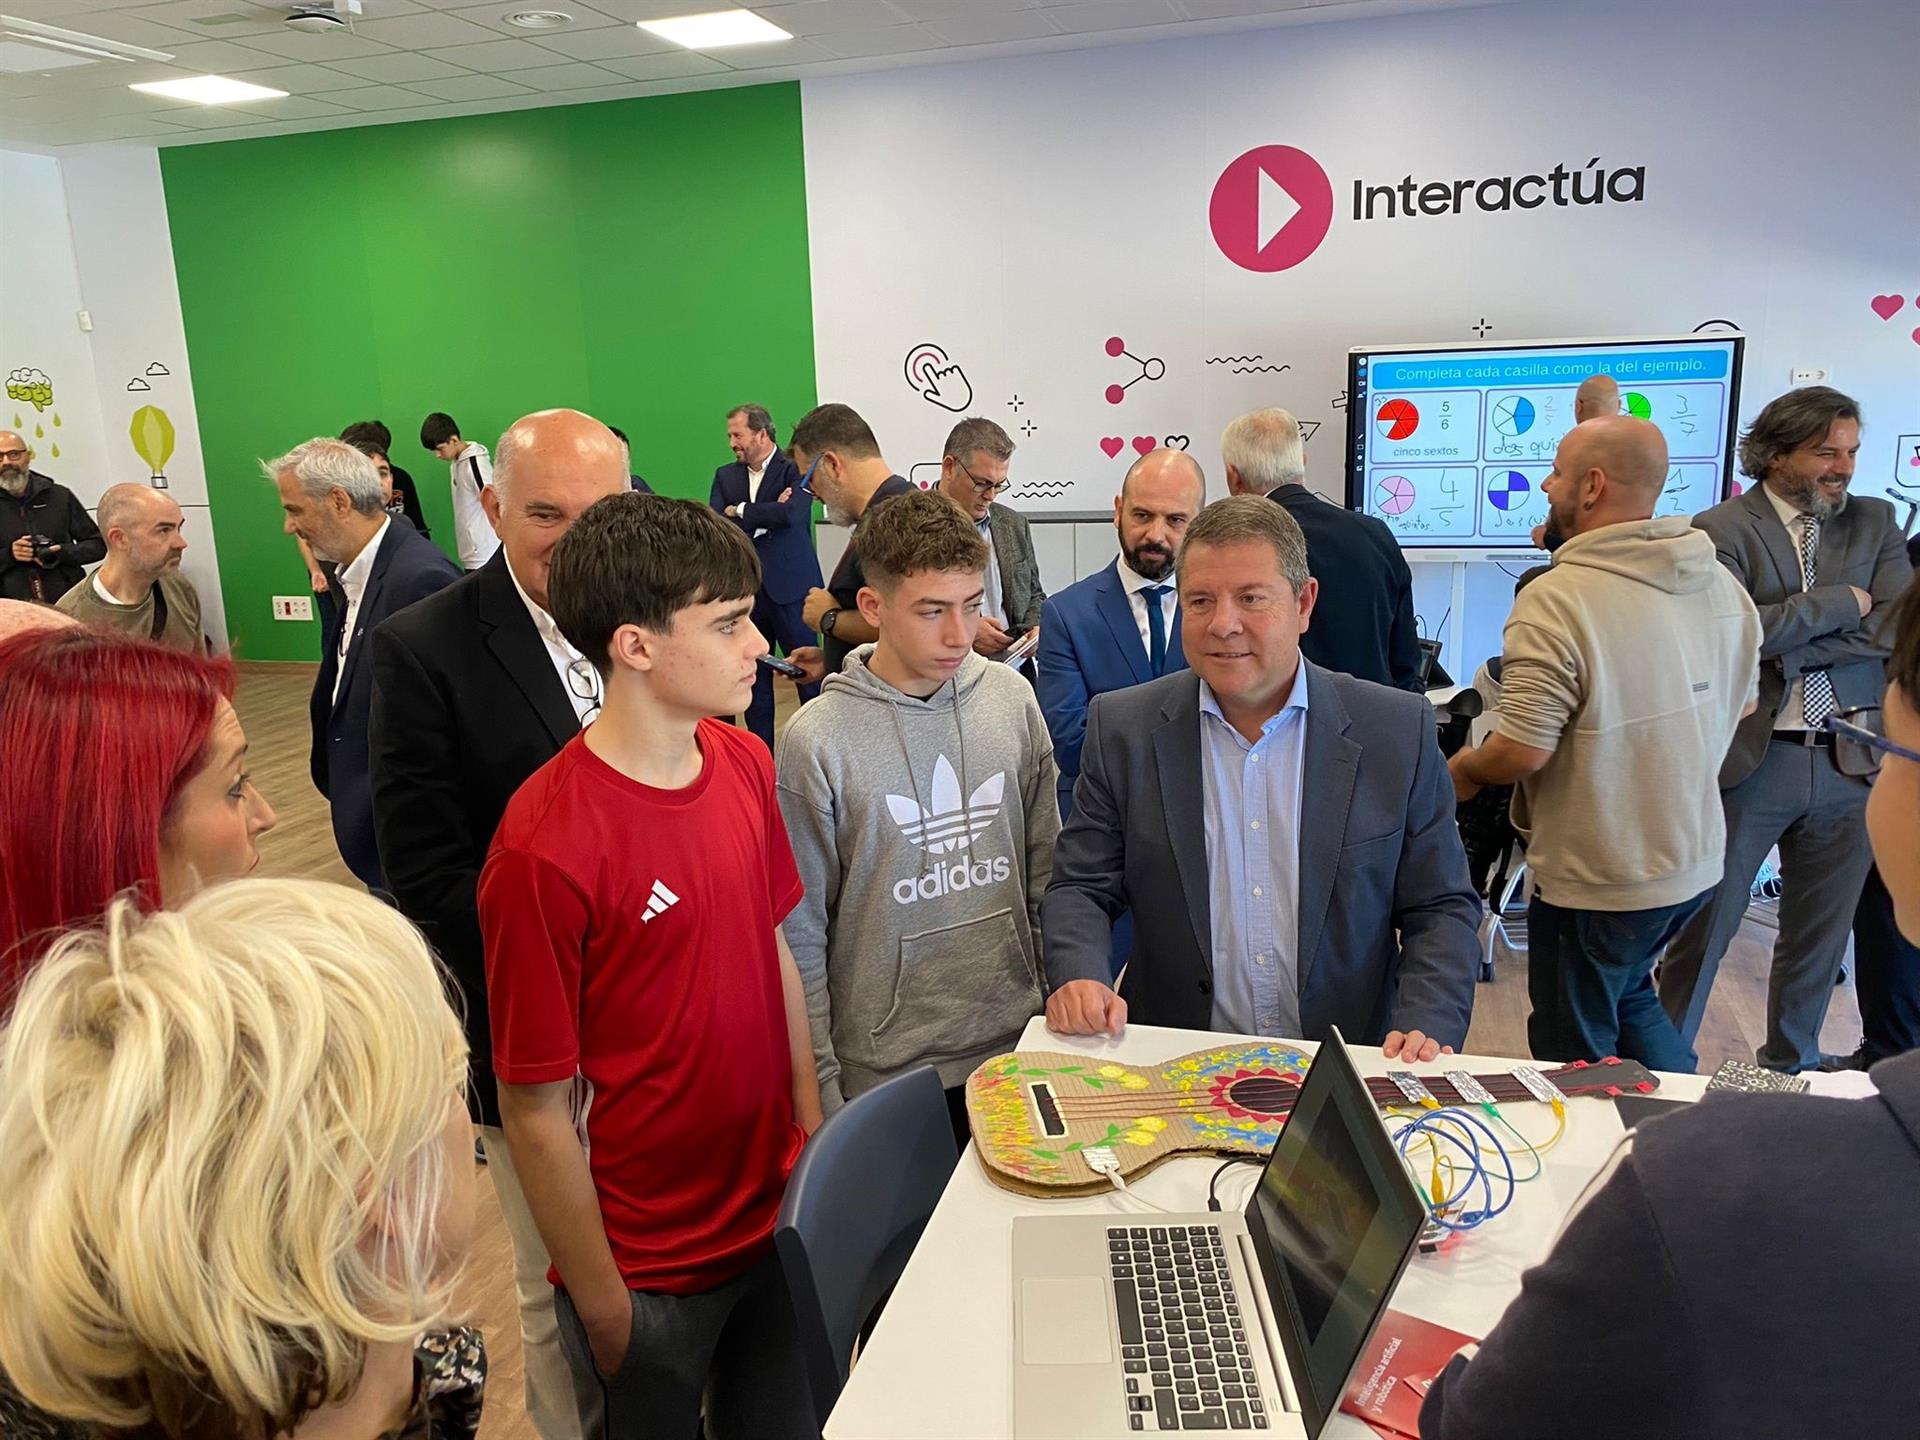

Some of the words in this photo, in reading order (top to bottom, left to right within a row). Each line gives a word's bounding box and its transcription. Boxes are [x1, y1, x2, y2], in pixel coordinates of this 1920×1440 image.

[1353, 157, 1646, 221] Interactúa
[1395, 367, 1462, 382] Completa
[1466, 365, 1500, 378] cada
[1504, 363, 1549, 377] casilla
[1553, 364, 1594, 375] como
[1599, 361, 1611, 374] la
[1615, 360, 1638, 373] del
[1643, 358, 1707, 375] ejemplo.
[1442, 401, 1450, 413] 5
[1676, 395, 1688, 414] 3
[1441, 418, 1450, 430] 6
[1679, 421, 1699, 437] 7
[1393, 446, 1421, 457] cinco
[1424, 445, 1459, 457] sextos
[1440, 469, 1459, 502] 4
[1438, 510, 1454, 527] 5
[892, 855, 1011, 905] adidas
[1354, 1363, 1386, 1407] Inteligencia
[1380, 1337, 1402, 1366] artificial
[1375, 1375, 1398, 1406] robótica
[1371, 1403, 1383, 1414] y
